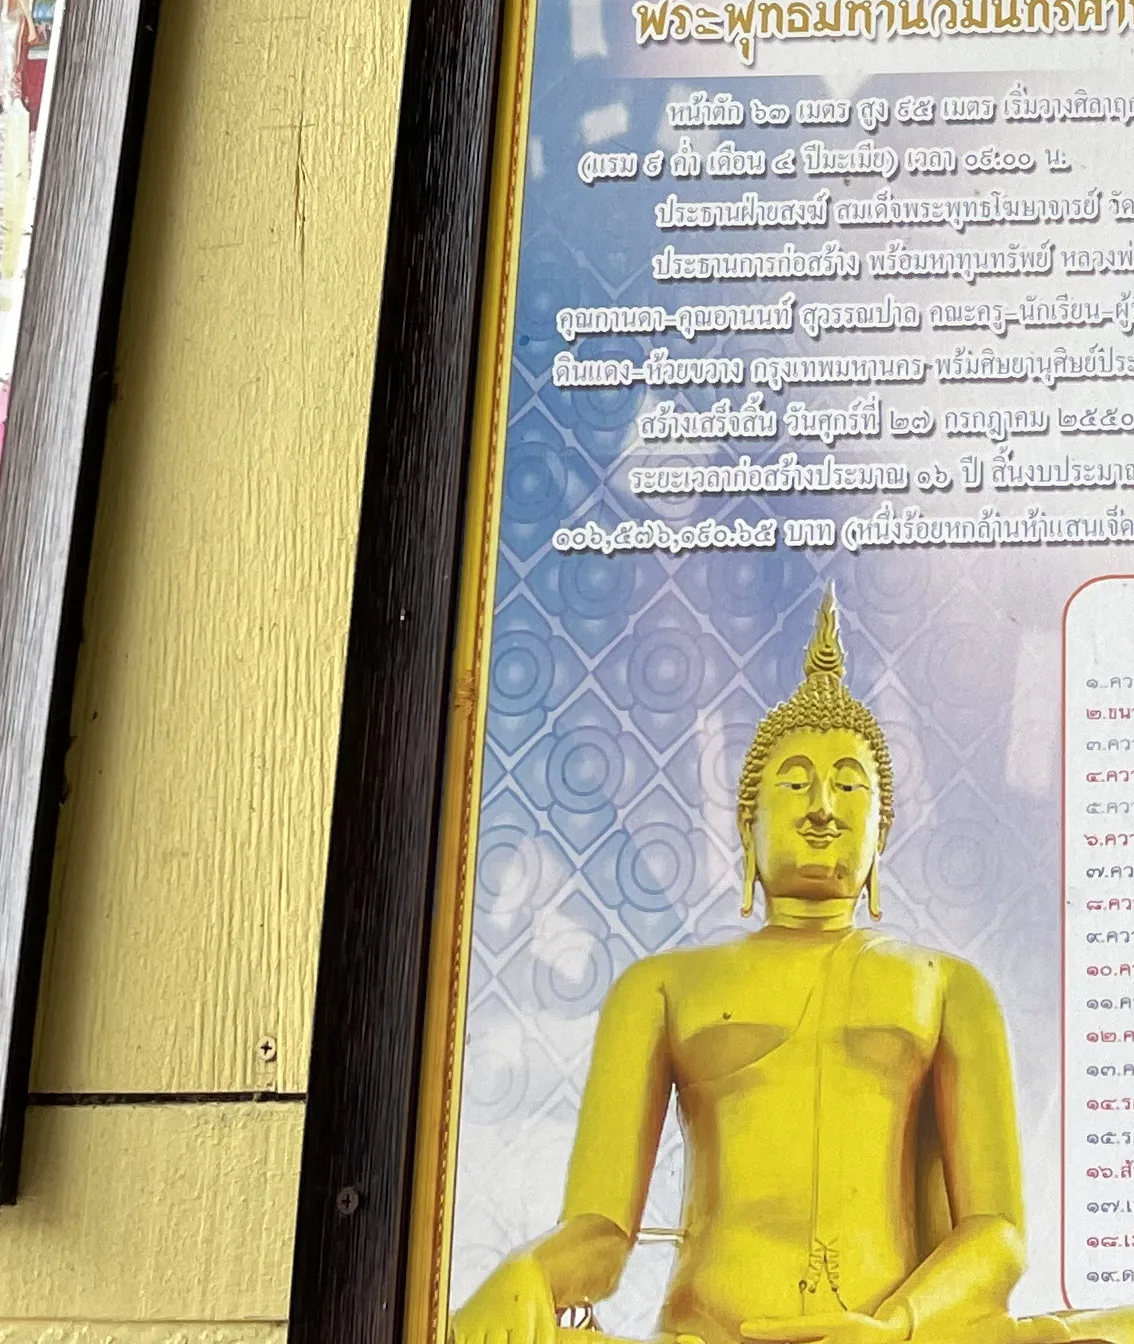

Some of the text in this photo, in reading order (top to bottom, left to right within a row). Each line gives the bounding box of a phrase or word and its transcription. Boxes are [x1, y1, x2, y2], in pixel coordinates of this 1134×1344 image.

[666, 90, 743, 127] หน้าตัก
[750, 97, 790, 126] ๖๓
[796, 97, 850, 124] เมตร
[857, 93, 888, 132] สูง
[895, 94, 934, 123] ๙๕
[940, 94, 996, 121] เมตร
[578, 150, 638, 184] (แรม
[670, 135, 700, 176] ค่ำ
[706, 140, 765, 176] เดือน
[771, 148, 796, 175] ๔
[800, 139, 899, 180] ปีมะเมีย)
[905, 146, 957, 176] เวลา
[656, 189, 831, 230] ประธานฝ่ายสงฆ์
[652, 239, 860, 281] ประธานการก่อสร้าง
[868, 238, 1056, 284] พร้อมหาทุนทรัพย์
[556, 293, 796, 340] คุณกานดา-คุณอานนท์
[799, 295, 922, 337] สุวรรณปาล
[552, 347, 746, 388] ดินแดง-ห้วยขวาง
[750, 354, 927, 389] กรุงเทพมหานคร
[638, 391, 777, 439] สร้างเสร็จสิ้น
[782, 395, 882, 445] วันศุกร์ที่
[888, 412, 936, 437] ๒๗
[943, 408, 1050, 442] กรกฎาคม
[628, 456, 910, 495] ระยะเวลาก่อสร้างประมาณ
[916, 465, 953, 490] ๑๖
[961, 455, 983, 491] ปี
[784, 517, 835, 550] บาท
